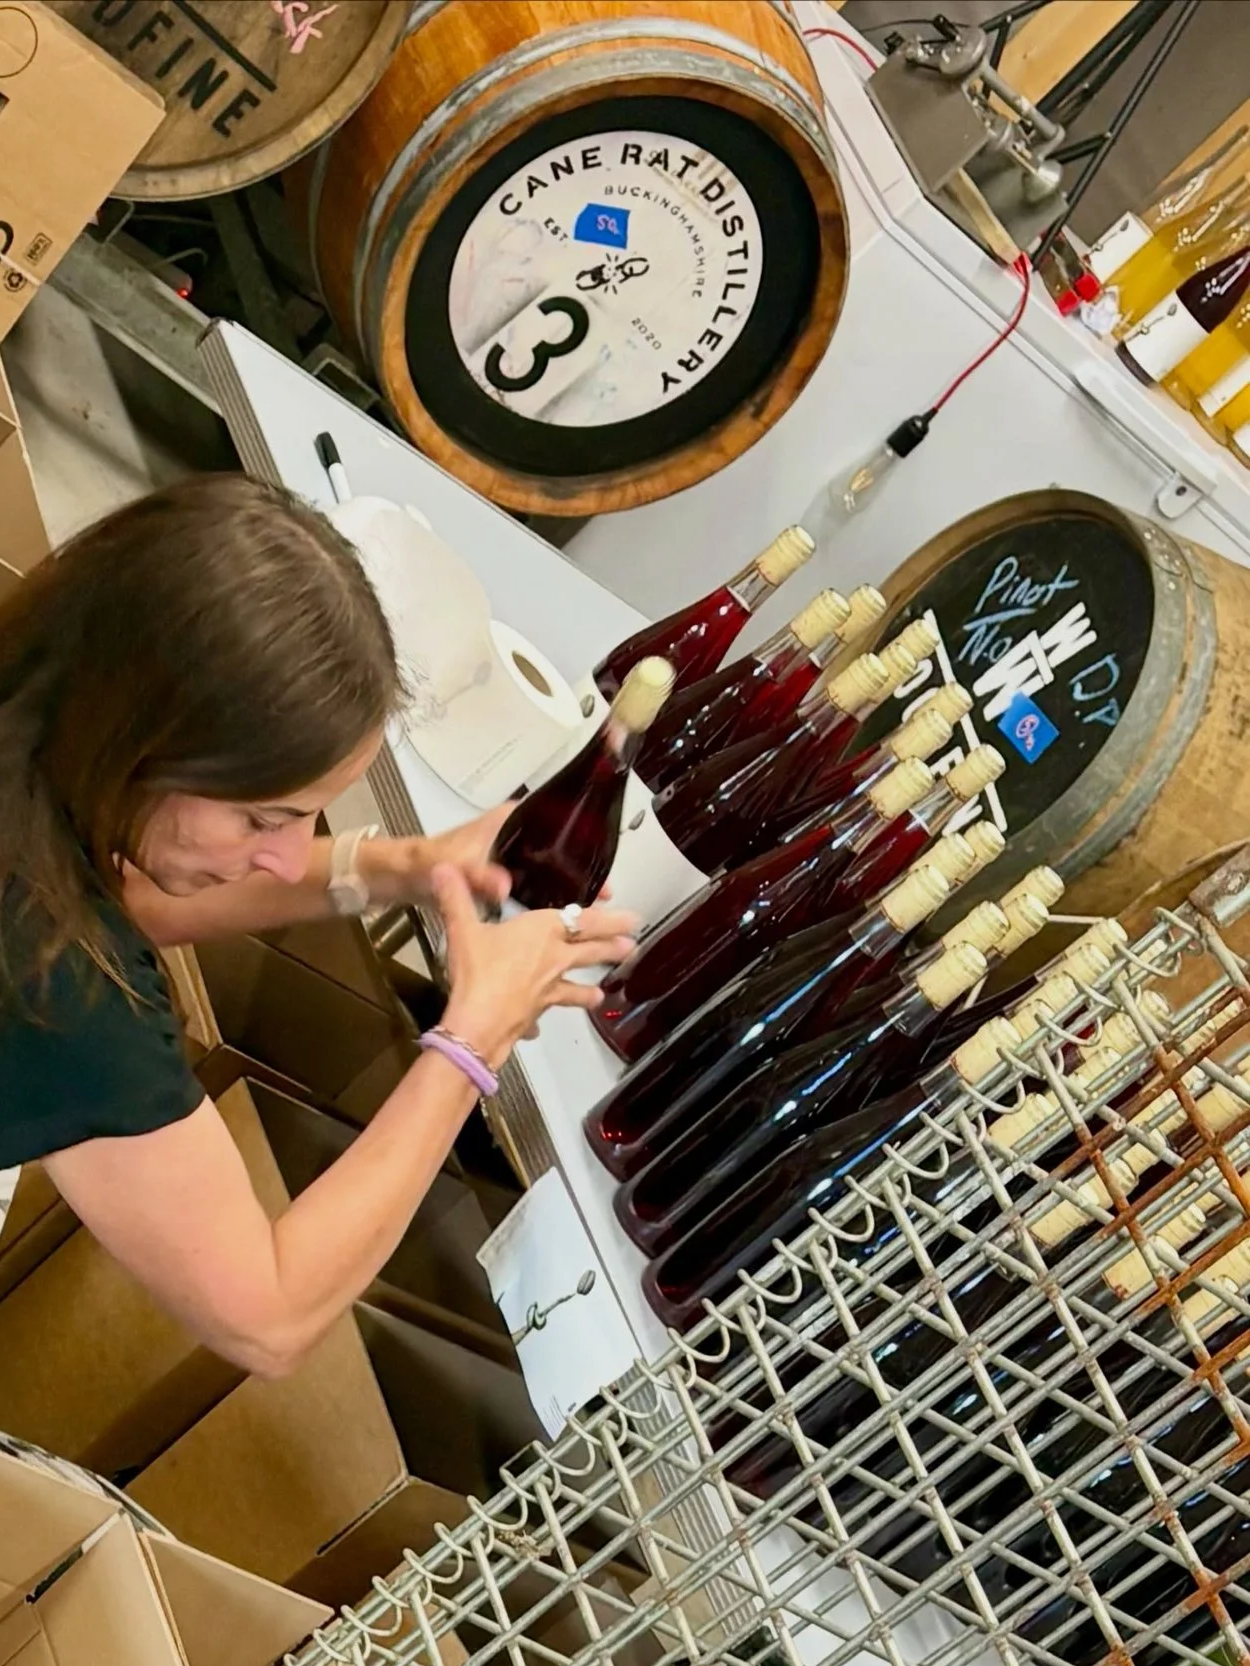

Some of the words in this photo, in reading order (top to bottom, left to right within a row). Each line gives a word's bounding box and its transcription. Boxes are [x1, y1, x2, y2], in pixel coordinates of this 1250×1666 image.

[499, 146, 602, 217] CANE
[620, 143, 699, 180] RAT
[661, 181, 750, 394] DISTILLERY
[604, 185, 707, 299] BUCKINGHAMSHIRE
[484, 295, 590, 394] 3
[631, 317, 663, 350] 2020
[974, 556, 1079, 613] Pinot
